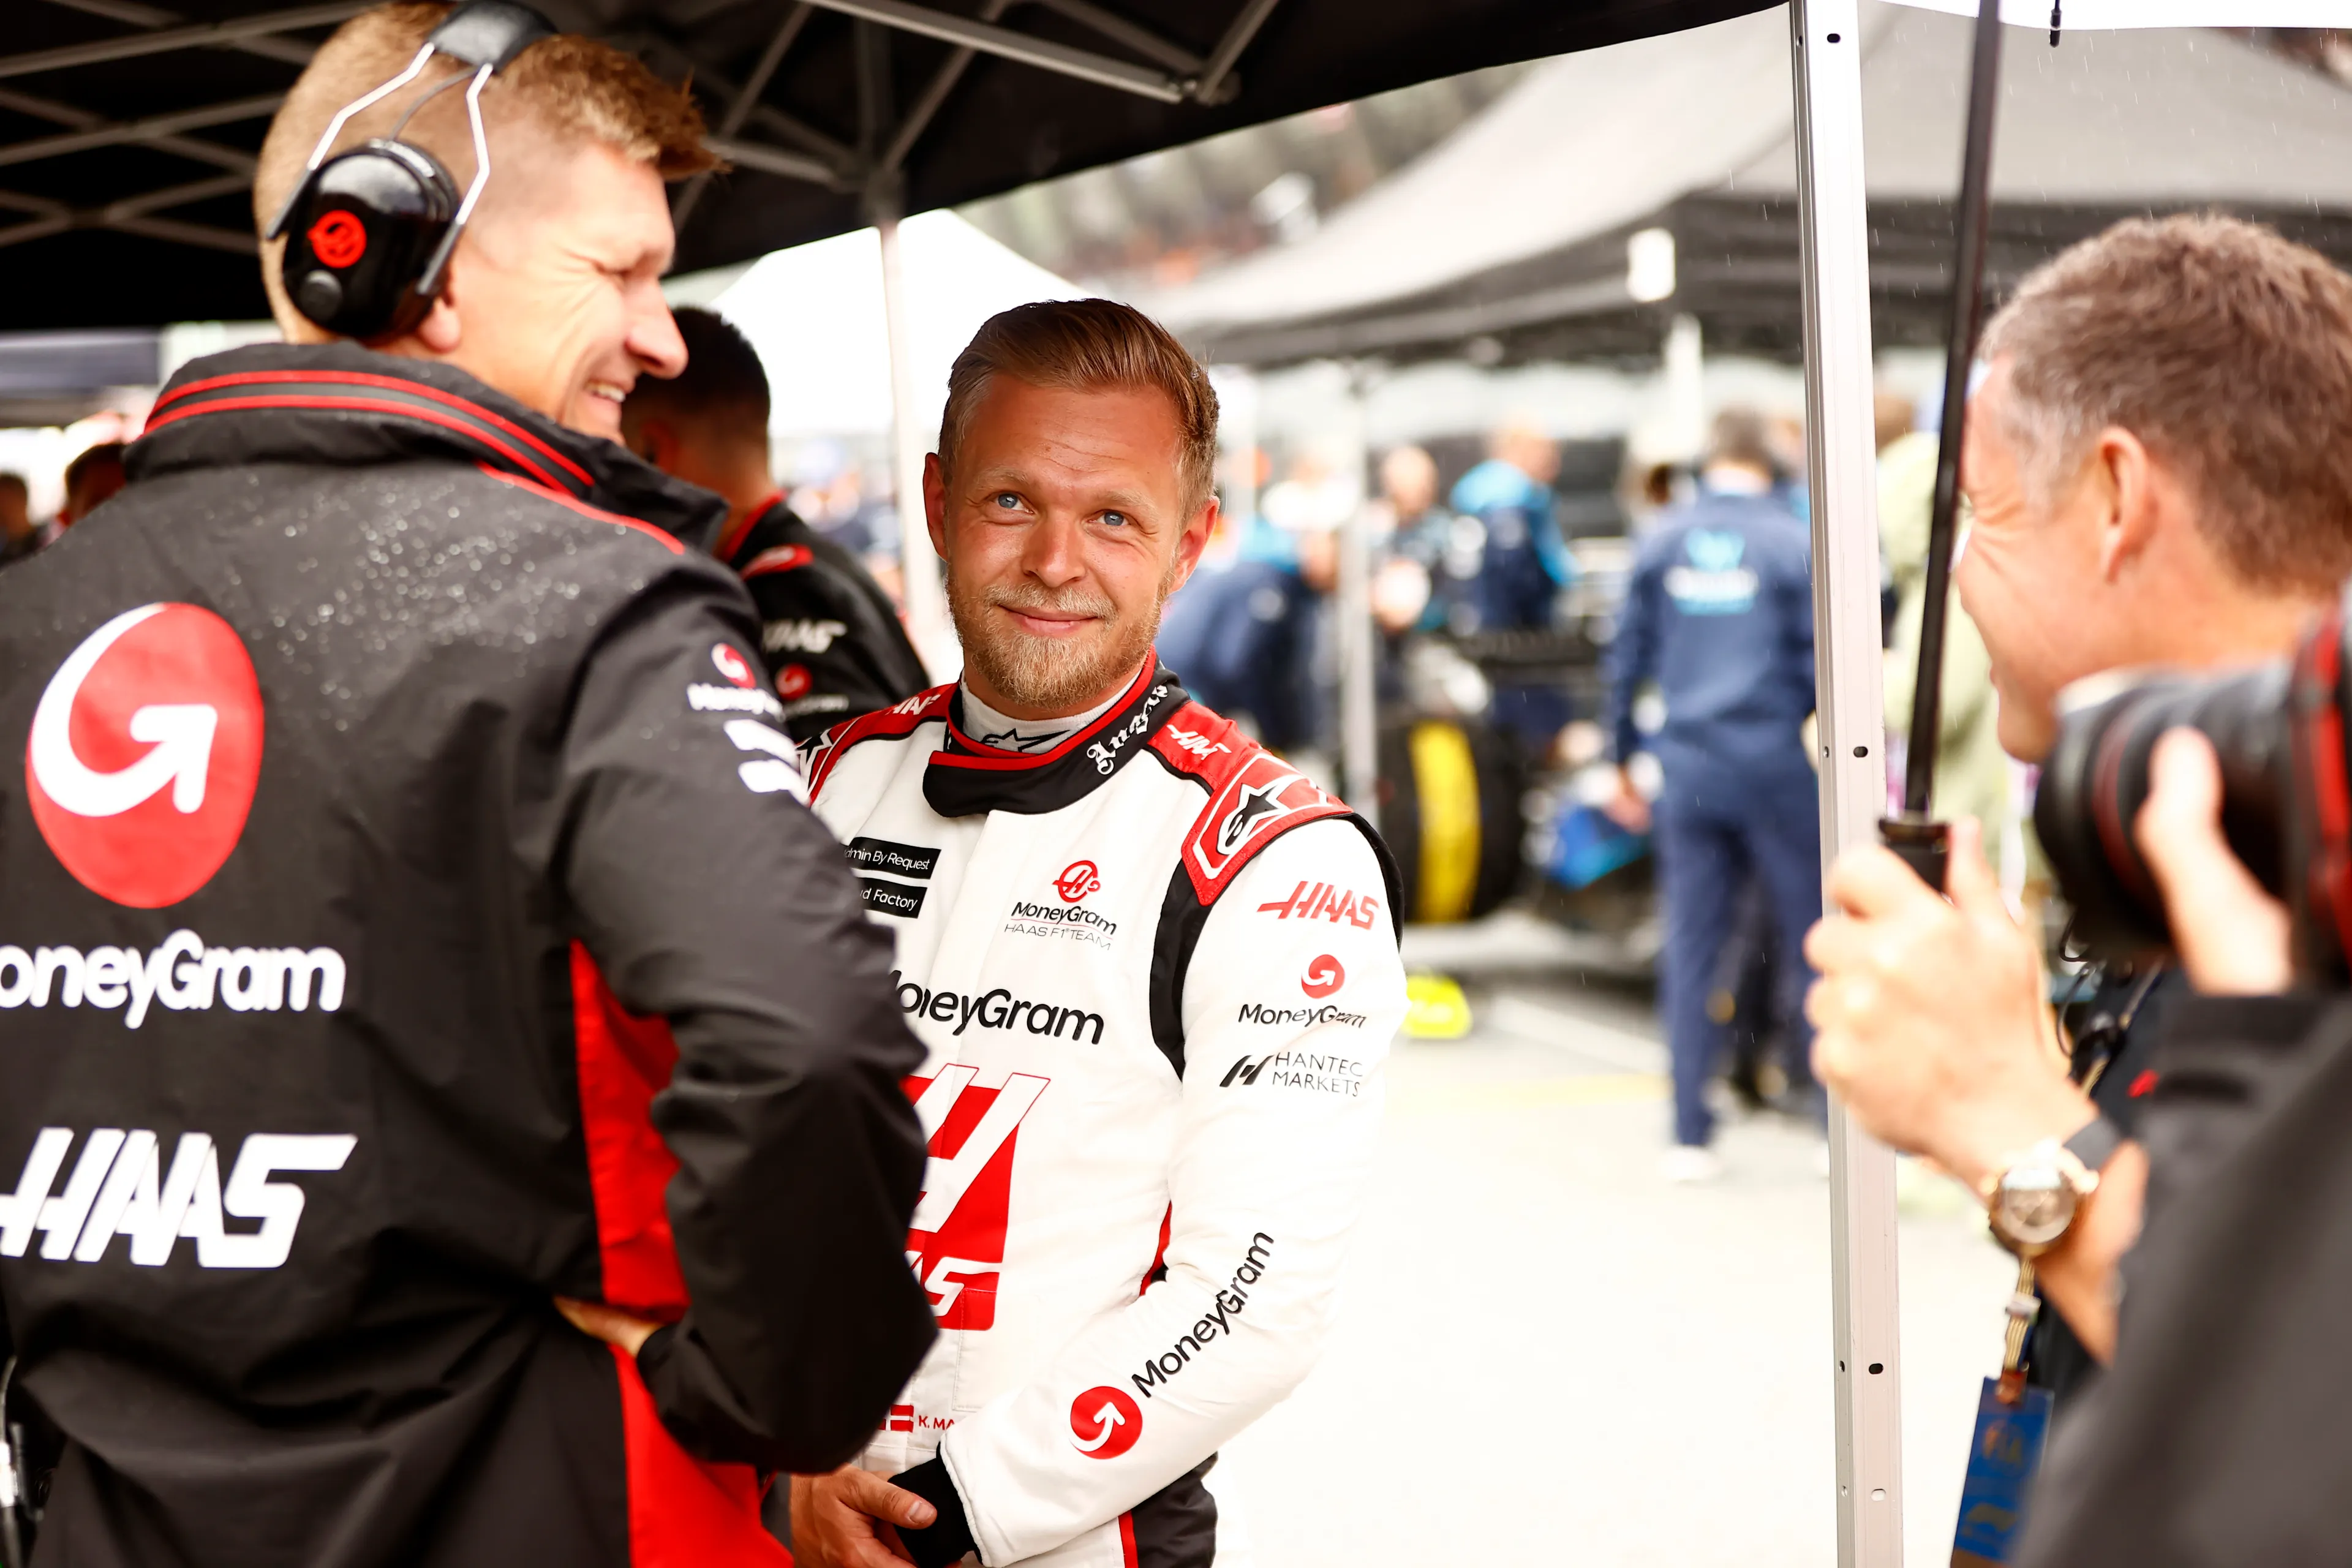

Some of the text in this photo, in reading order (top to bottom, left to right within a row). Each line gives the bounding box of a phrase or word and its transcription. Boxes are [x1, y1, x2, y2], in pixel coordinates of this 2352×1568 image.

[872, 850, 888, 865] By
[887, 852, 930, 871] Request
[873, 889, 918, 911] Factory
[1256, 880, 1380, 931] HAAS
[1004, 924, 1048, 937] HAAS
[1011, 902, 1117, 935] MoneyGram
[0, 929, 347, 1029] oneyGram
[1274, 1051, 1363, 1077] HANTEC
[1272, 1071, 1360, 1098] MARKETS
[0, 1126, 359, 1268] HAAS
[1131, 1232, 1275, 1398] MoneyGram
[919, 1414, 930, 1429] K.
